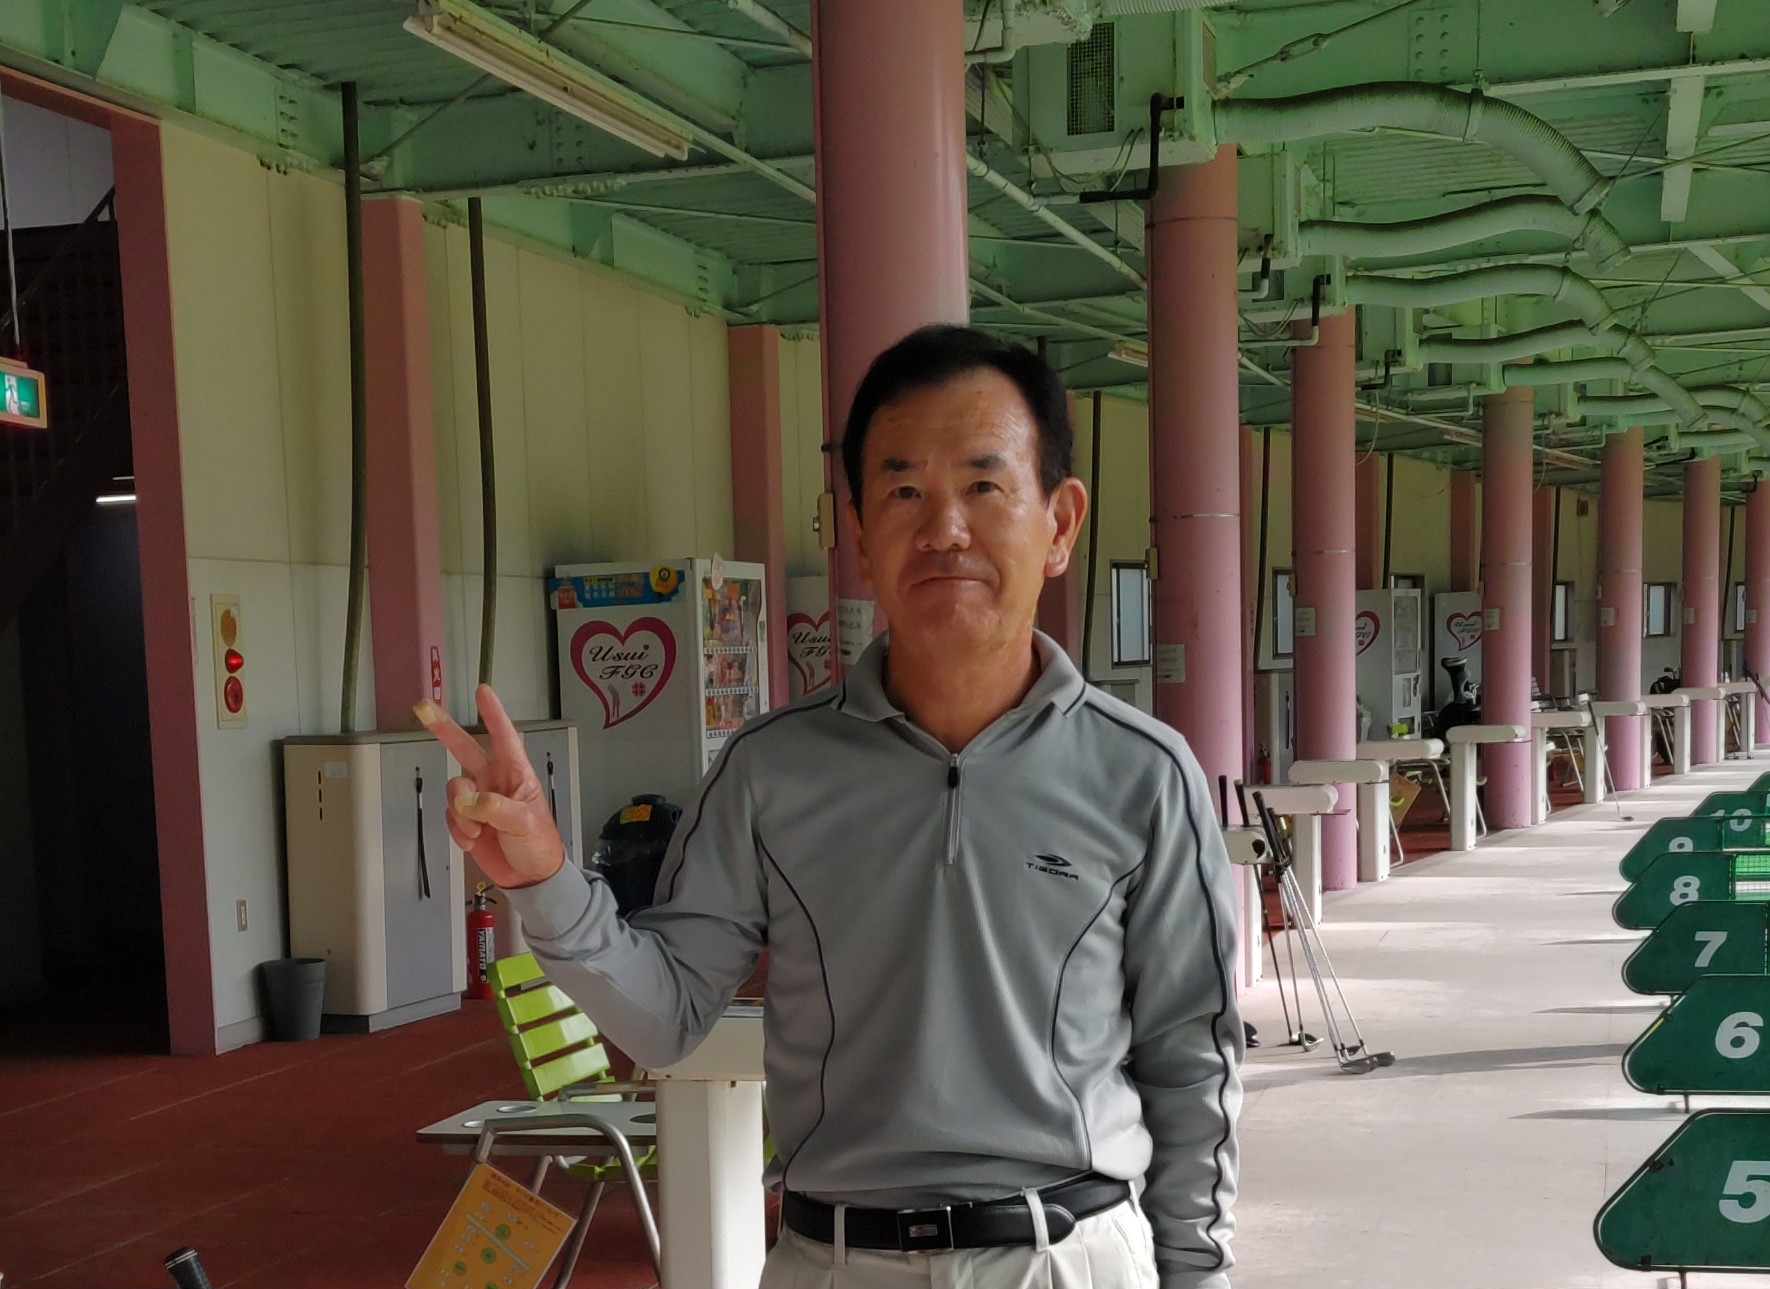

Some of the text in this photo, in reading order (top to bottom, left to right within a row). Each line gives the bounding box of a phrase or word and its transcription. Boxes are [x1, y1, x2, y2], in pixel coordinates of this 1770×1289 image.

[589, 644, 649, 662] Usui
[792, 632, 831, 645] Usu
[599, 663, 659, 680] FGC
[1669, 875, 1700, 906] 8
[1694, 931, 1727, 967] 7
[1714, 1012, 1763, 1059] 6
[1718, 1160, 1770, 1223] 5
